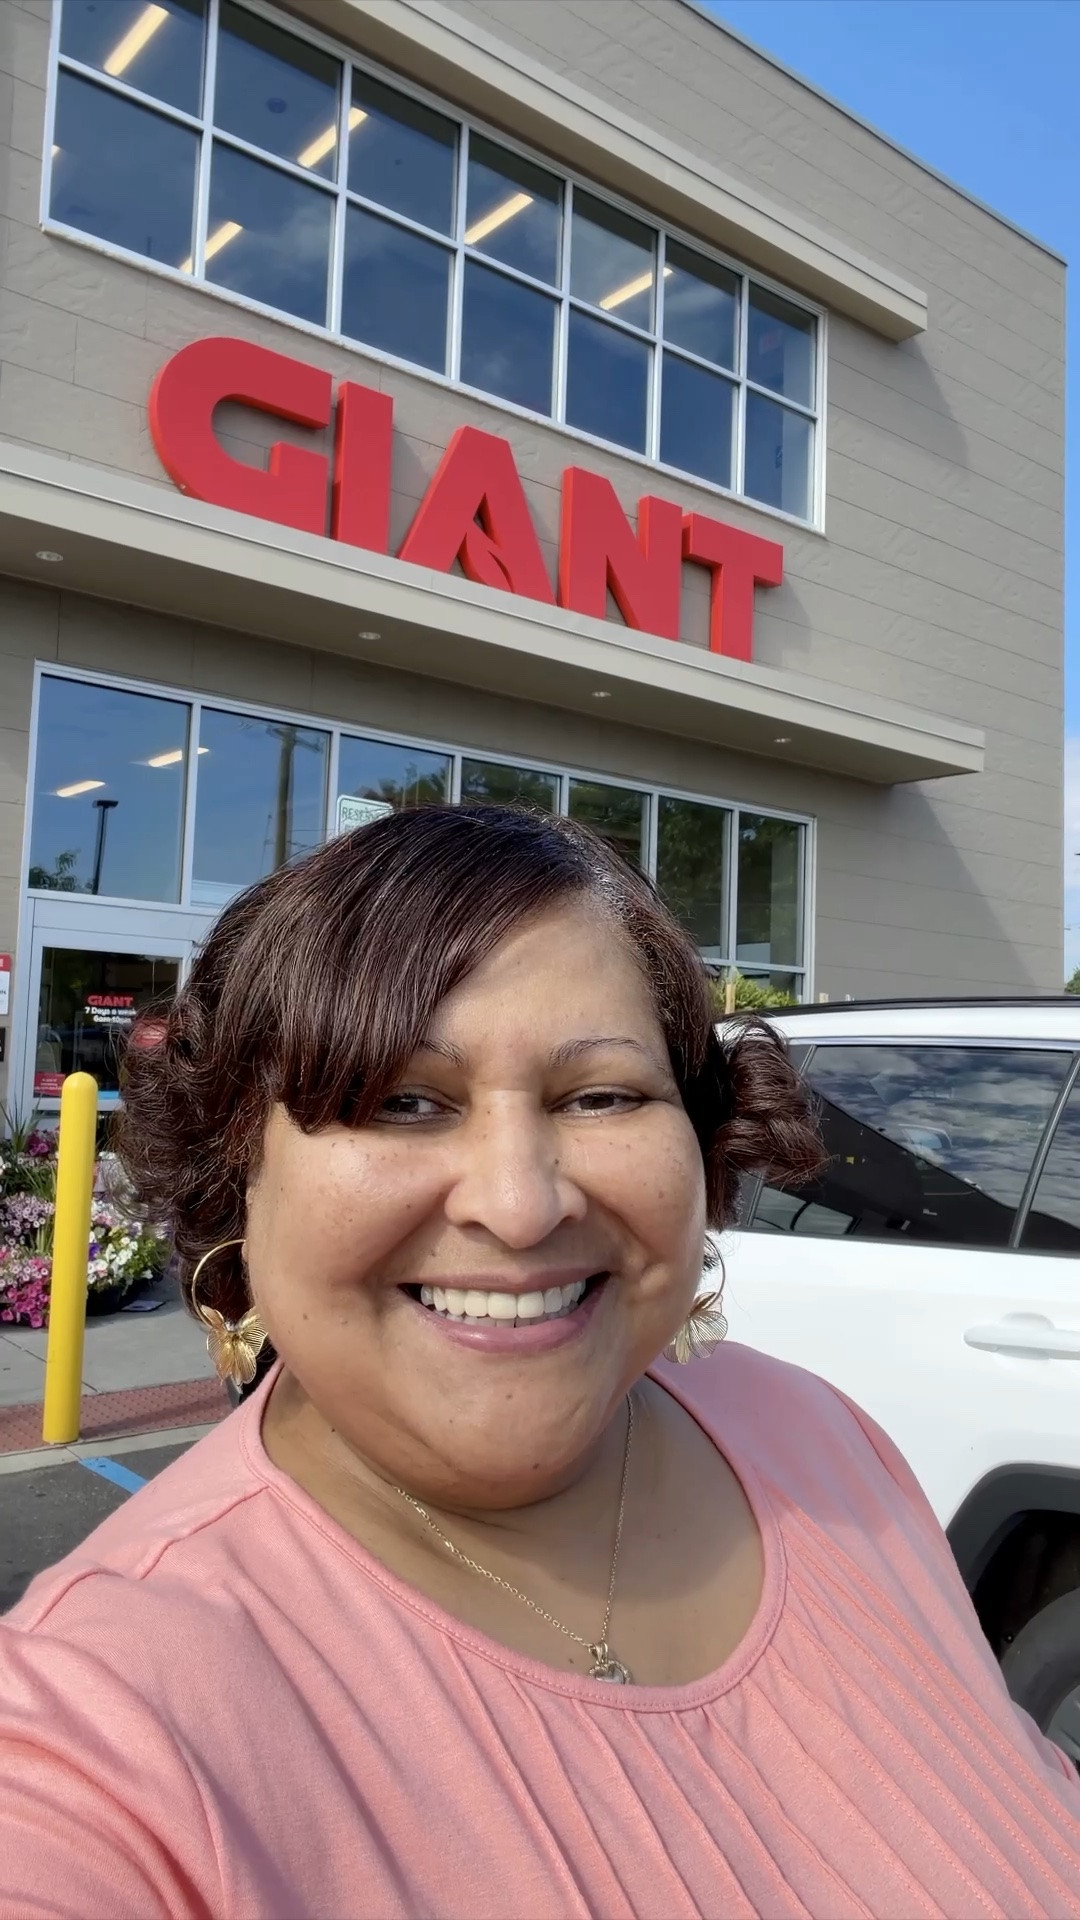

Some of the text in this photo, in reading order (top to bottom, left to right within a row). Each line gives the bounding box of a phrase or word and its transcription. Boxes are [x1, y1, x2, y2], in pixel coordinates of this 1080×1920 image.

[149, 336, 784, 663] GIANT
[87, 994, 134, 1007] GIANT
[84, 1006, 90, 1014] 7
[91, 1006, 110, 1016] Days
